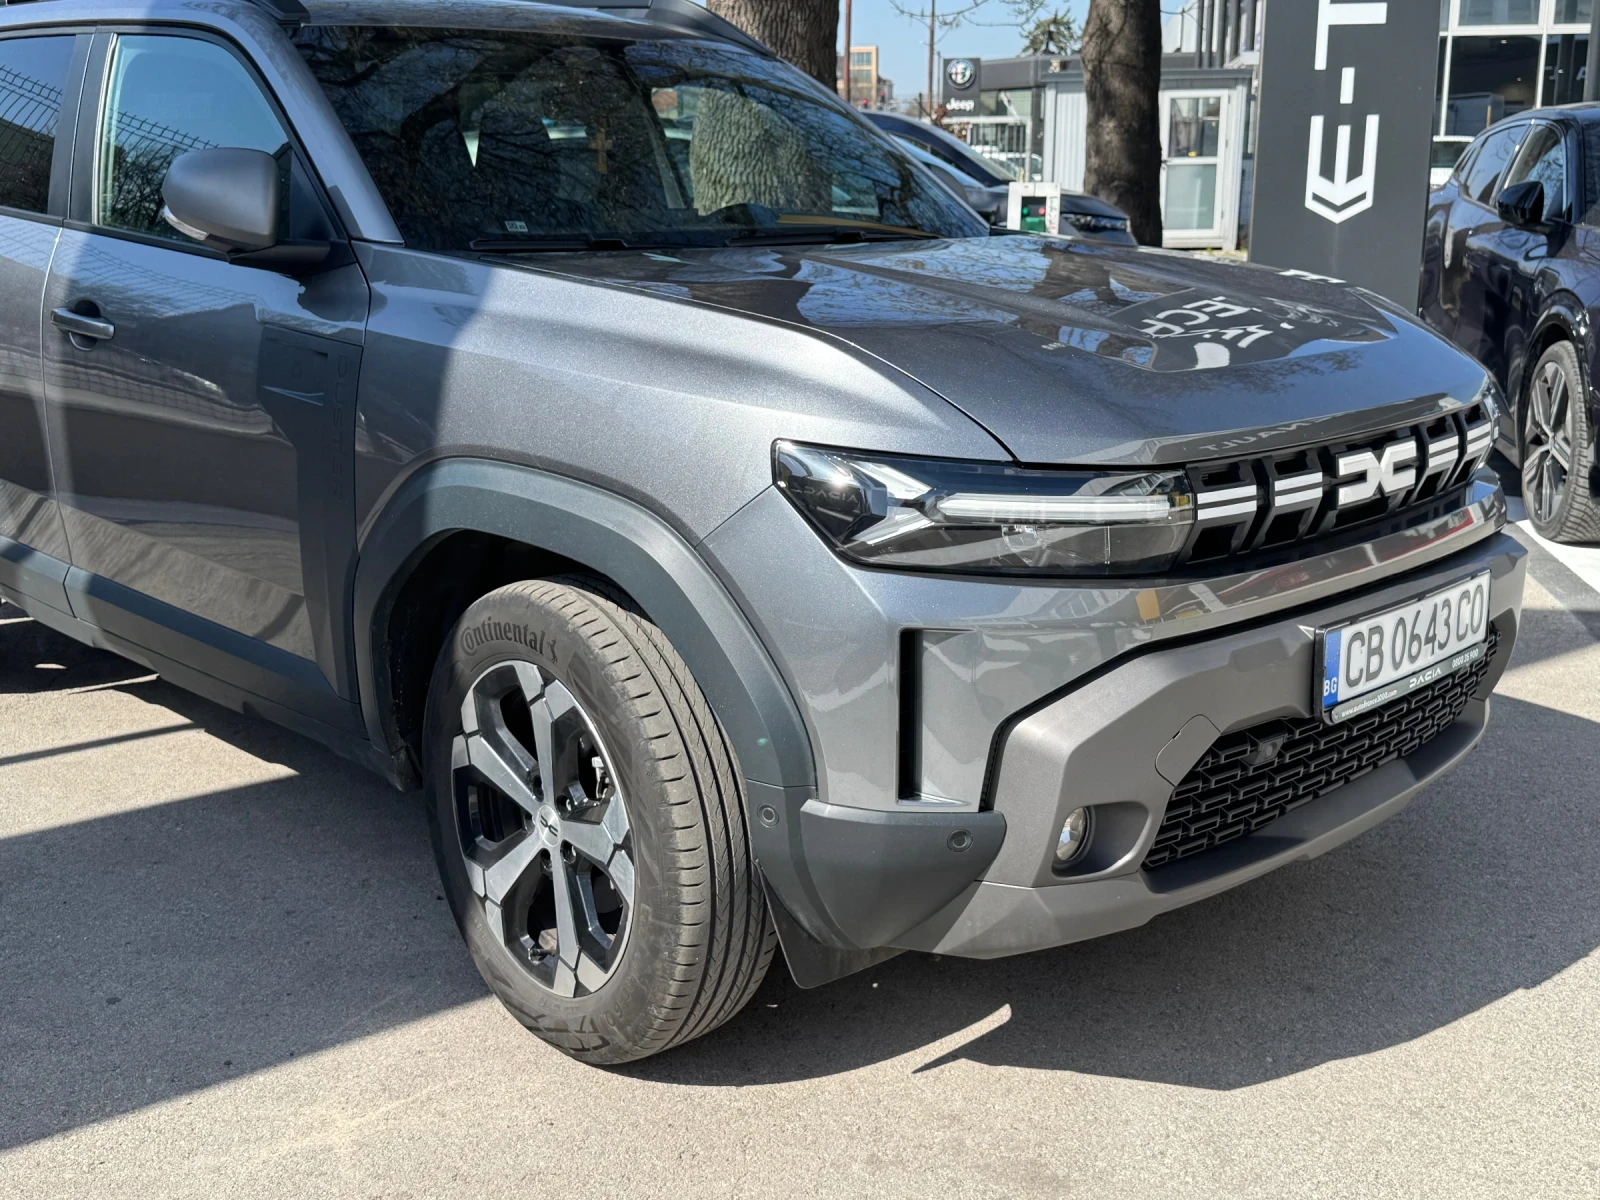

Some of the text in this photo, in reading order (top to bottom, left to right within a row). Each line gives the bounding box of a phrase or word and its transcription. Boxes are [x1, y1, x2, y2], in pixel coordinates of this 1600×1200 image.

[946, 98, 975, 111] Jeep
[803, 485, 859, 504] DACIA
[461, 616, 546, 656] Continental
[1345, 584, 1484, 688] CB 0643 CO
[1323, 677, 1338, 697] BG
[1409, 667, 1442, 689] DACIA
